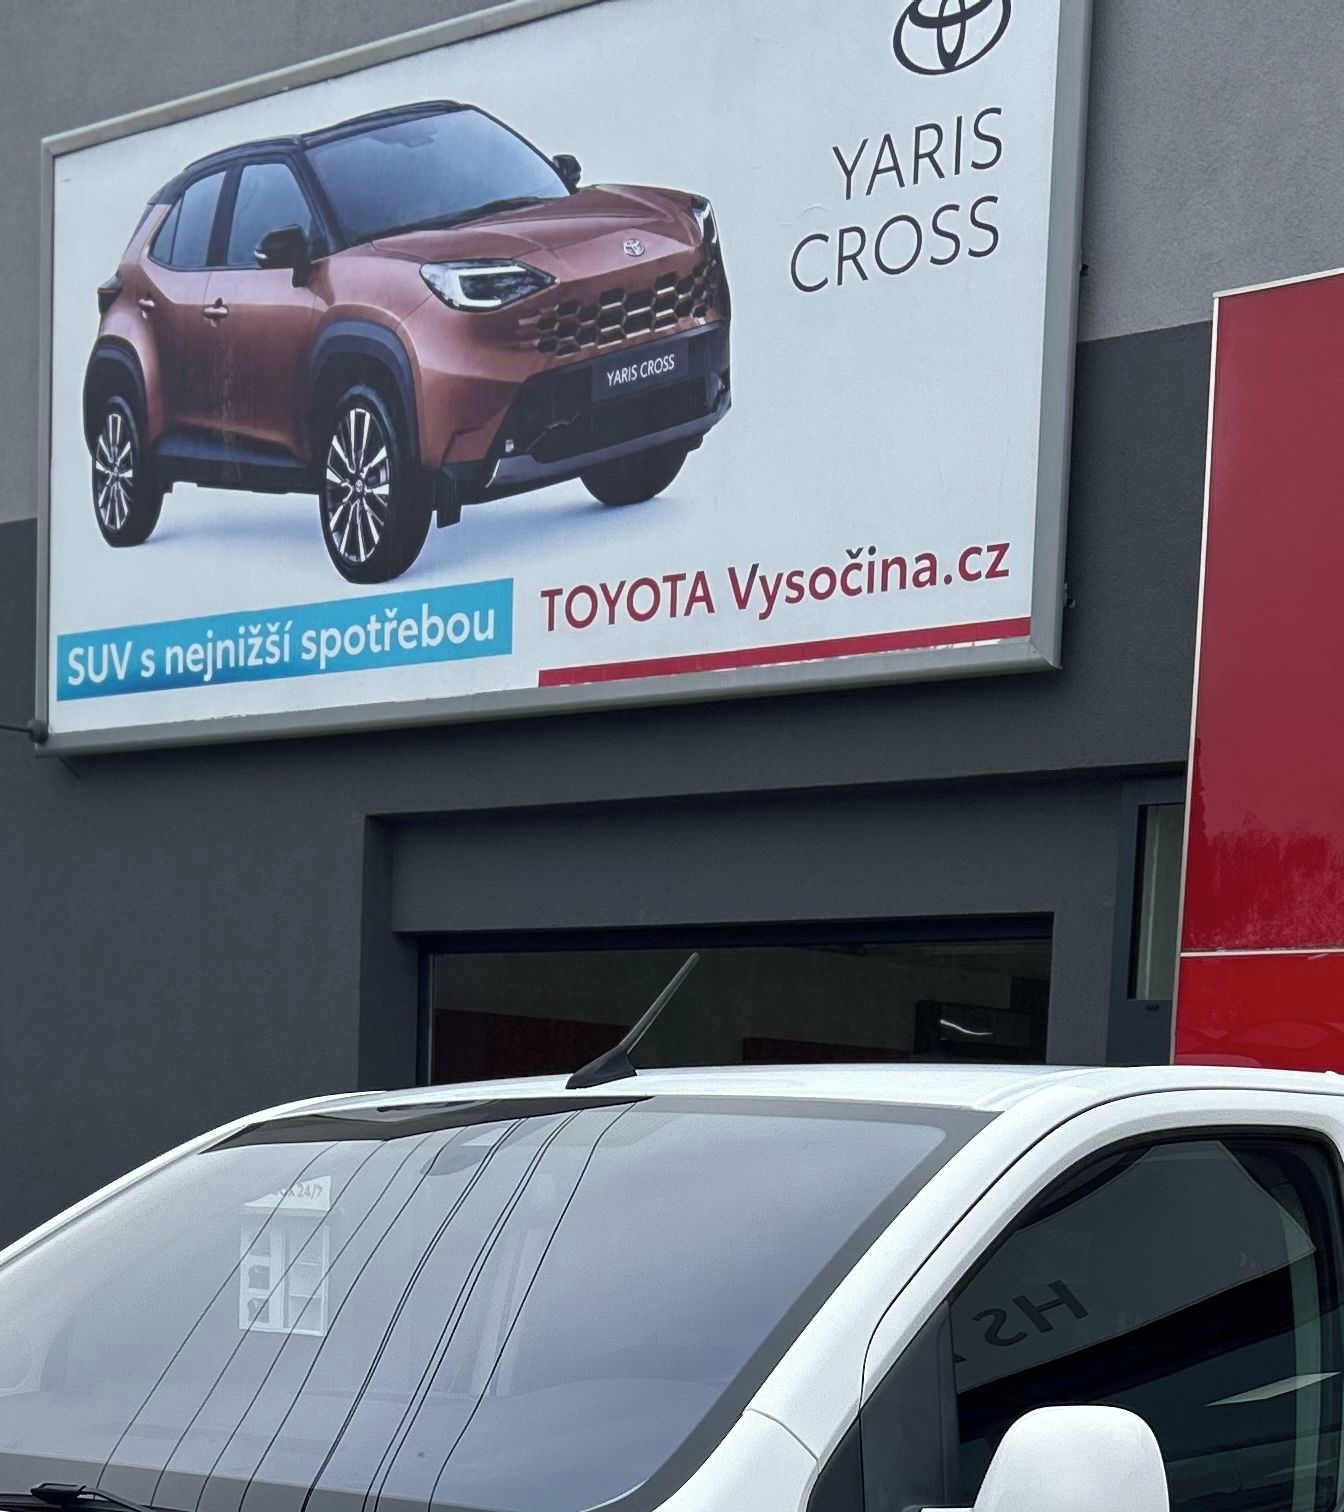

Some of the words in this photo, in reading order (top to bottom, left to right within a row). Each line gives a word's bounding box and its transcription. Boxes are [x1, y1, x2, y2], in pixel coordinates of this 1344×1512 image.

[832, 106, 1003, 201] YARIS
[789, 194, 1000, 294] CROSS
[607, 364, 638, 387] YARIS
[640, 353, 675, 378] CROSS
[540, 570, 715, 632] TOYOTA
[727, 542, 1011, 621] Vysočina.cz
[67, 640, 133, 687] SUV
[139, 647, 155, 678] s
[165, 619, 293, 682] nejnižší
[301, 602, 495, 670] spotřebou
